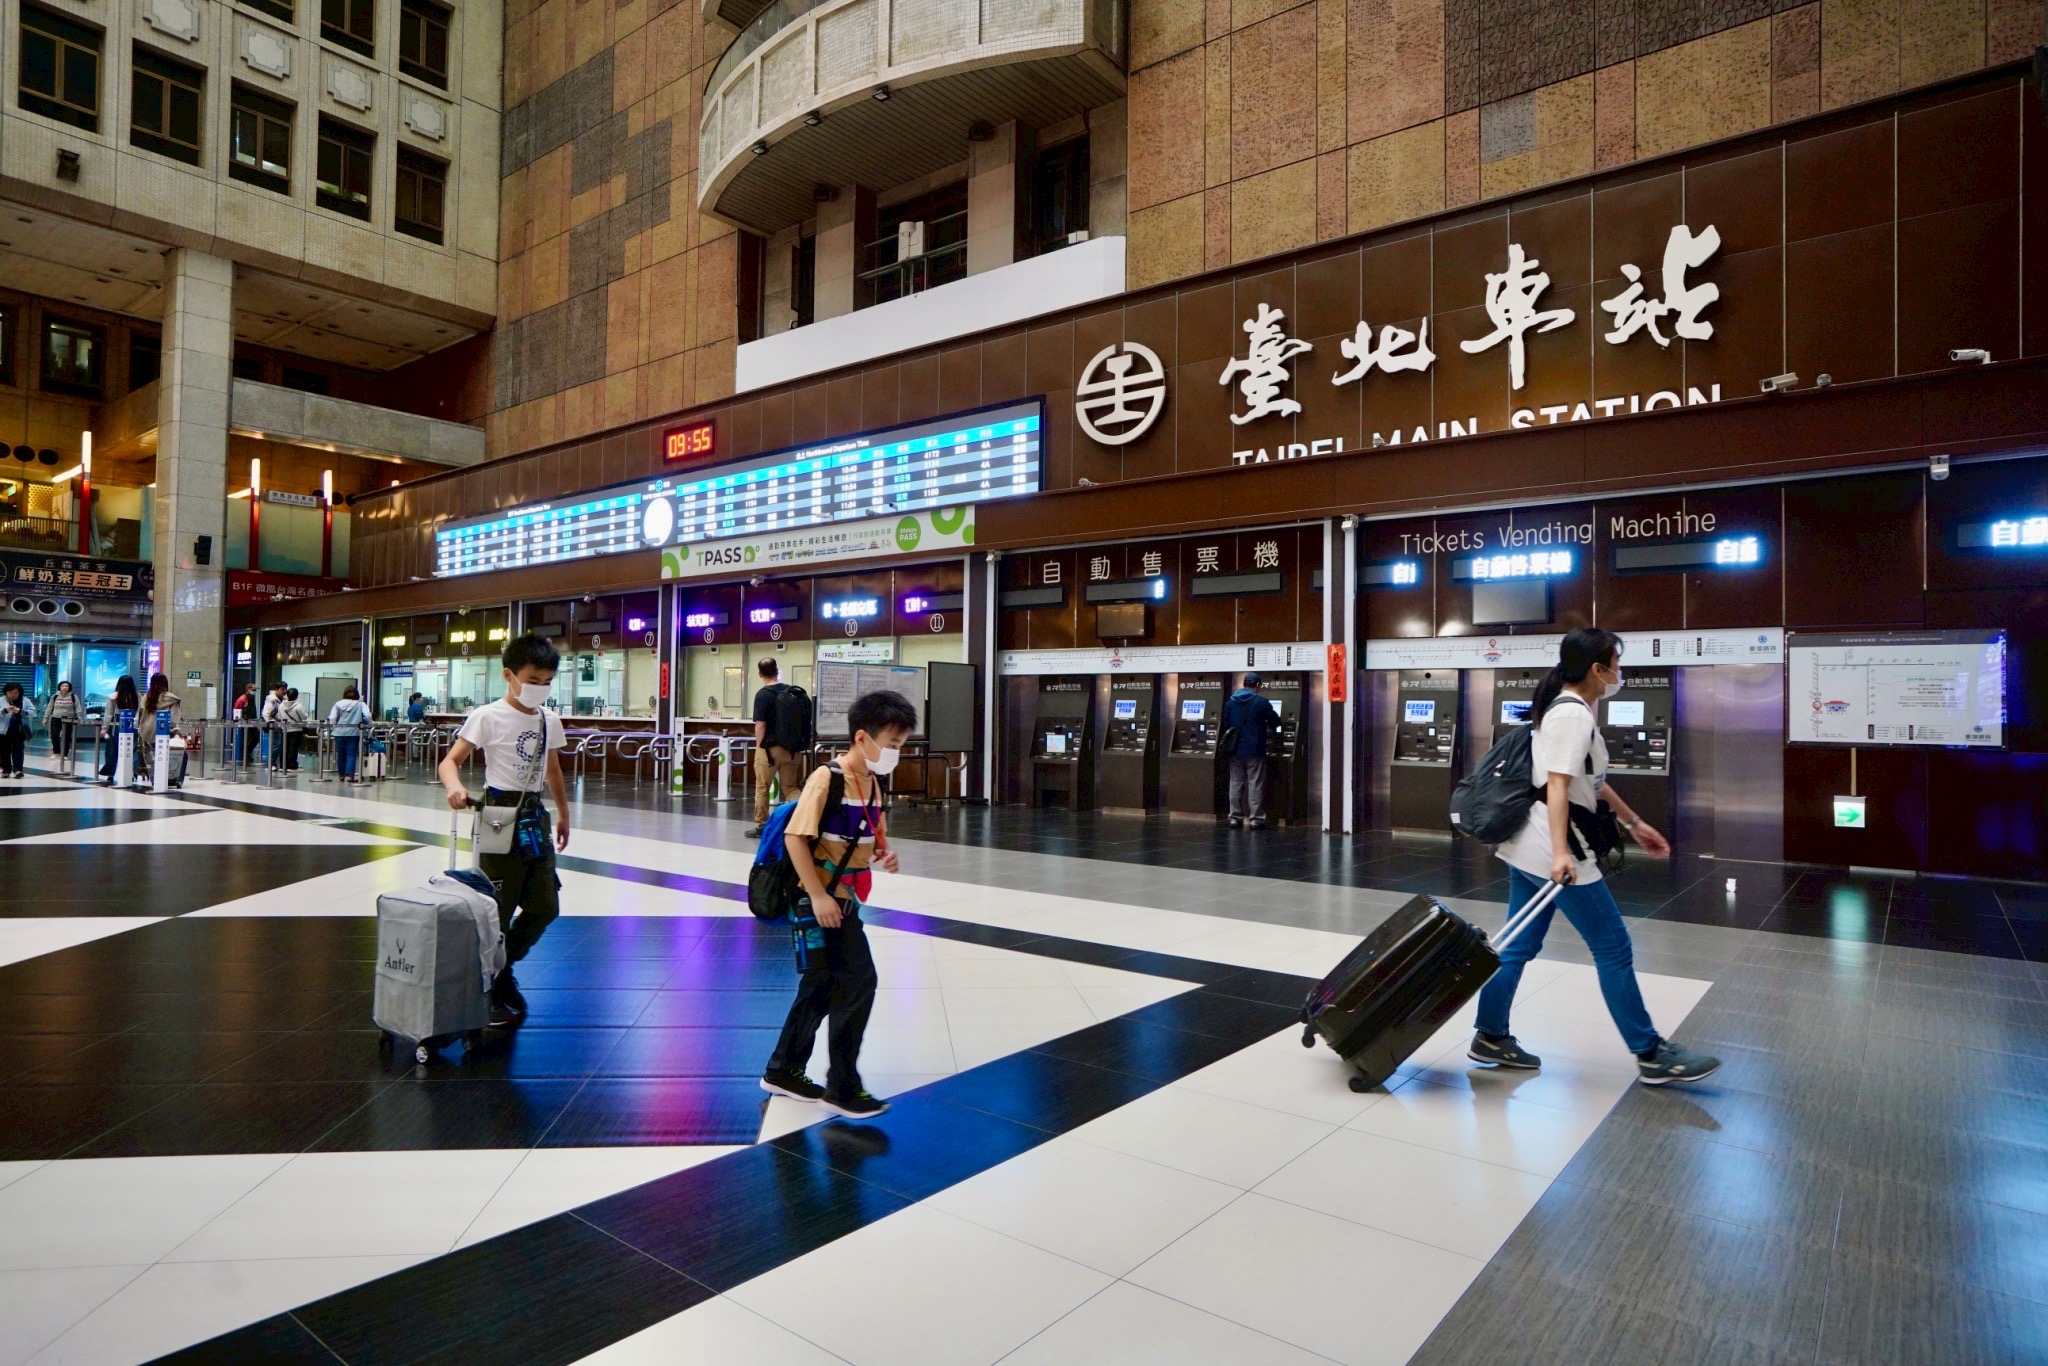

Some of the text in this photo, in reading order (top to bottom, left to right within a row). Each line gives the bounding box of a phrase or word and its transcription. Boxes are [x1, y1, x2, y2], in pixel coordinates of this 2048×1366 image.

[1219, 224, 1722, 426] 臺北車站
[668, 426, 711, 458] 09:55
[899, 532, 918, 541] PASS
[1401, 512, 1717, 555] Tickets Vending Machine
[696, 547, 742, 567] TPASS
[1043, 541, 1279, 584] 自動售票機
[18, 568, 130, 589] 鮮奶茶三冠王
[233, 582, 253, 591] B1F
[188, 672, 200, 680] F28
[1627, 677, 1669, 685] 自動售票機
[384, 955, 415, 974] Antler
